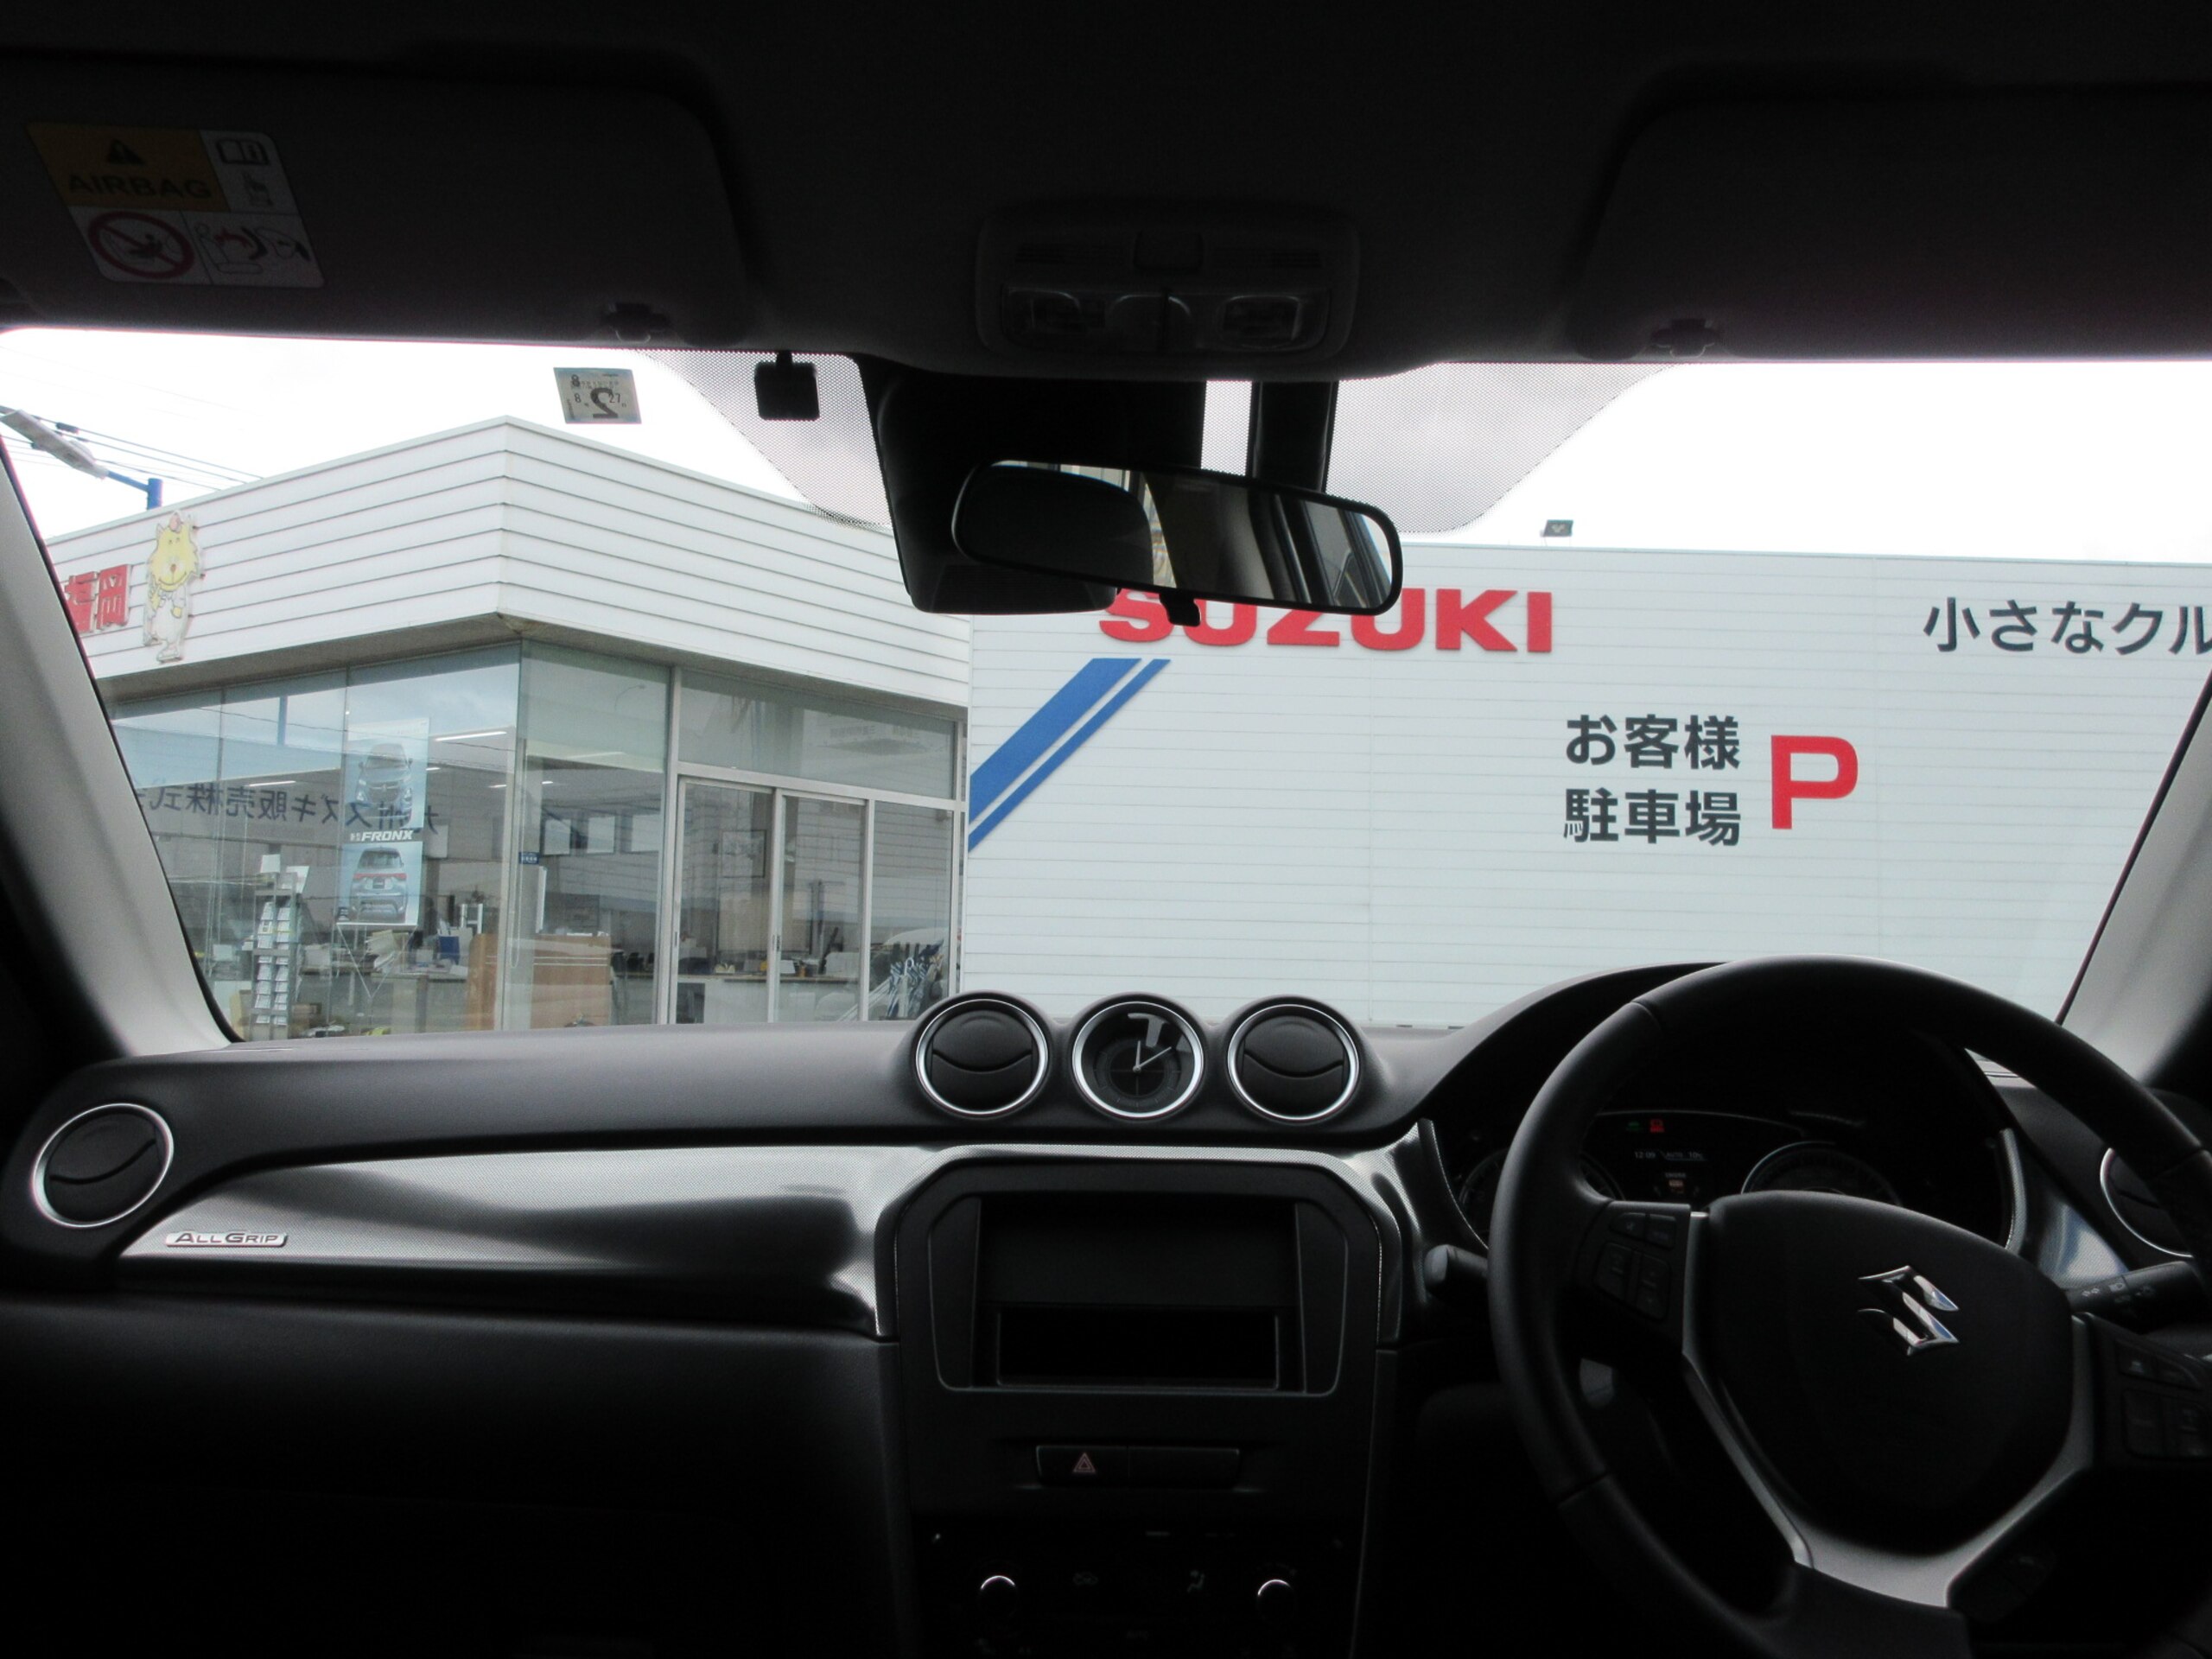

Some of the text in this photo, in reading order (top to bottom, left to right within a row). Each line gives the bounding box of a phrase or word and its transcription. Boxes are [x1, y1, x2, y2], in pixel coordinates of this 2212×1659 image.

[68, 174, 212, 199] AIRBAG
[1099, 588, 1553, 653] SUZUKI
[1923, 597, 2212, 655] 小さなクル
[1564, 714, 1741, 771] お客様
[1770, 735, 1859, 830] P
[361, 830, 414, 842] FRONX
[1563, 787, 1741, 846] 駐車場
